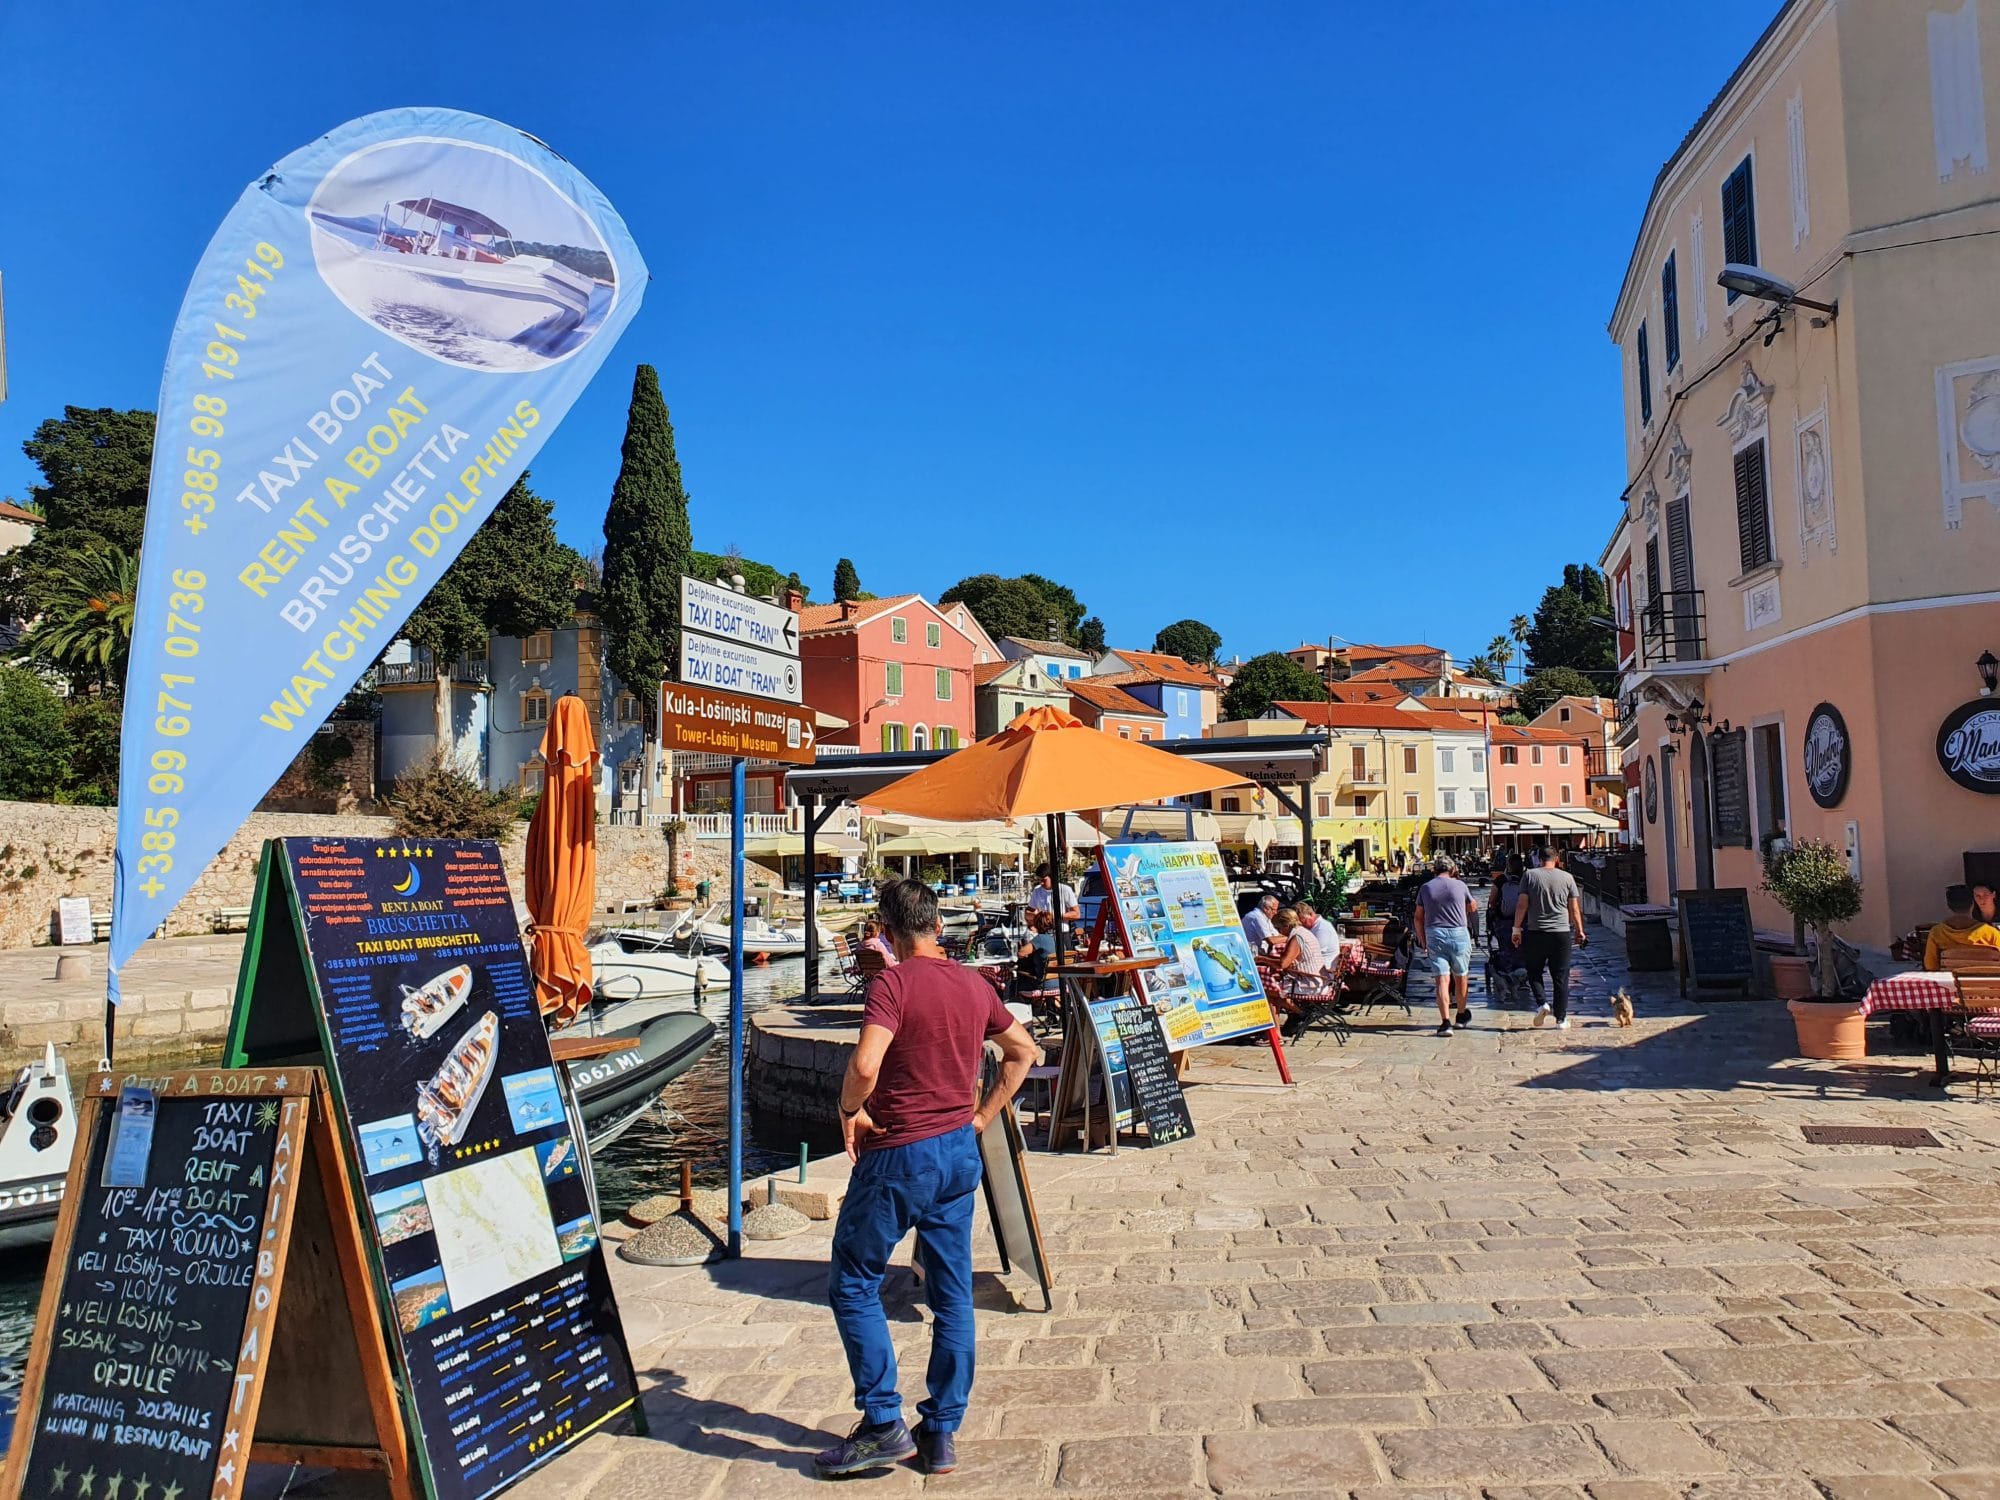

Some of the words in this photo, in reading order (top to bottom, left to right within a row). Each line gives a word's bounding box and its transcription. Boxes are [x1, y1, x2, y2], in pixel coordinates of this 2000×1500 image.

[224, 241, 286, 319] 3419
[201, 323, 241, 380] 191
[190, 394, 228, 439] 98
[236, 437, 319, 515] TAXI
[306, 351, 394, 447] BOAT
[182, 448, 222, 535] +385
[238, 498, 330, 598] RENT
[323, 480, 361, 511] A
[345, 387, 430, 479] BOAT
[279, 423, 470, 633] BRUSCHETTA
[260, 554, 419, 731] WATCHING
[408, 400, 541, 559] DOLPHINS
[164, 569, 207, 659] 0736
[688, 583, 721, 605] Delphine
[722, 596, 756, 616] excursions
[688, 602, 712, 629] TAXI
[715, 612, 743, 633] BOAT
[688, 638, 721, 657] Delphine
[722, 650, 758, 666] excursions
[688, 657, 712, 682] TAXI
[715, 665, 744, 685] BOAT
[155, 673, 196, 737] 671
[665, 691, 751, 727] Kula-Lošinjski
[754, 711, 786, 734] muzej
[675, 724, 739, 752] Tower-Lošinj
[742, 733, 778, 753] Museum
[148, 750, 187, 795] 99
[1245, 770, 1295, 780] Heineken
[806, 785, 850, 794] Heineken
[139, 807, 180, 899] +385
[1163, 854, 1195, 868] HAPPY
[381, 902, 408, 913] RENT
[410, 902, 418, 912] A
[418, 900, 444, 912] BOAT
[366, 913, 470, 935] BRUSCHETTA
[357, 940, 384, 954] TAXI
[385, 939, 413, 952] BOAT
[416, 933, 481, 949] BRUSCHETTA
[400, 953, 418, 963] Robi
[180, 1074, 200, 1094] A
[209, 1074, 268, 1094] BOAT
[203, 1102, 253, 1125] TAXI
[191, 1126, 253, 1156] BOAT
[185, 1157, 241, 1183] RENT
[249, 1164, 264, 1189] A
[271, 1102, 299, 1223] TAXI
[186, 1187, 249, 1215] BOAT
[118, 1226, 164, 1251] TAXI
[171, 1228, 241, 1259] ROUND
[77, 1251, 107, 1272] VELI
[184, 1261, 252, 1287] ORJULE
[120, 1280, 178, 1306] ILOVIK
[75, 1301, 110, 1326] VELI
[234, 1250, 274, 1415] BOAT
[59, 1329, 116, 1353] SUSAK
[149, 1343, 208, 1374] ILOVIK
[94, 1361, 176, 1395] ORJULE
[52, 1393, 125, 1421] WATCHING
[136, 1399, 212, 1430] DOLPHINS
[44, 1416, 87, 1436] LUNCH
[92, 1422, 108, 1441] IN
